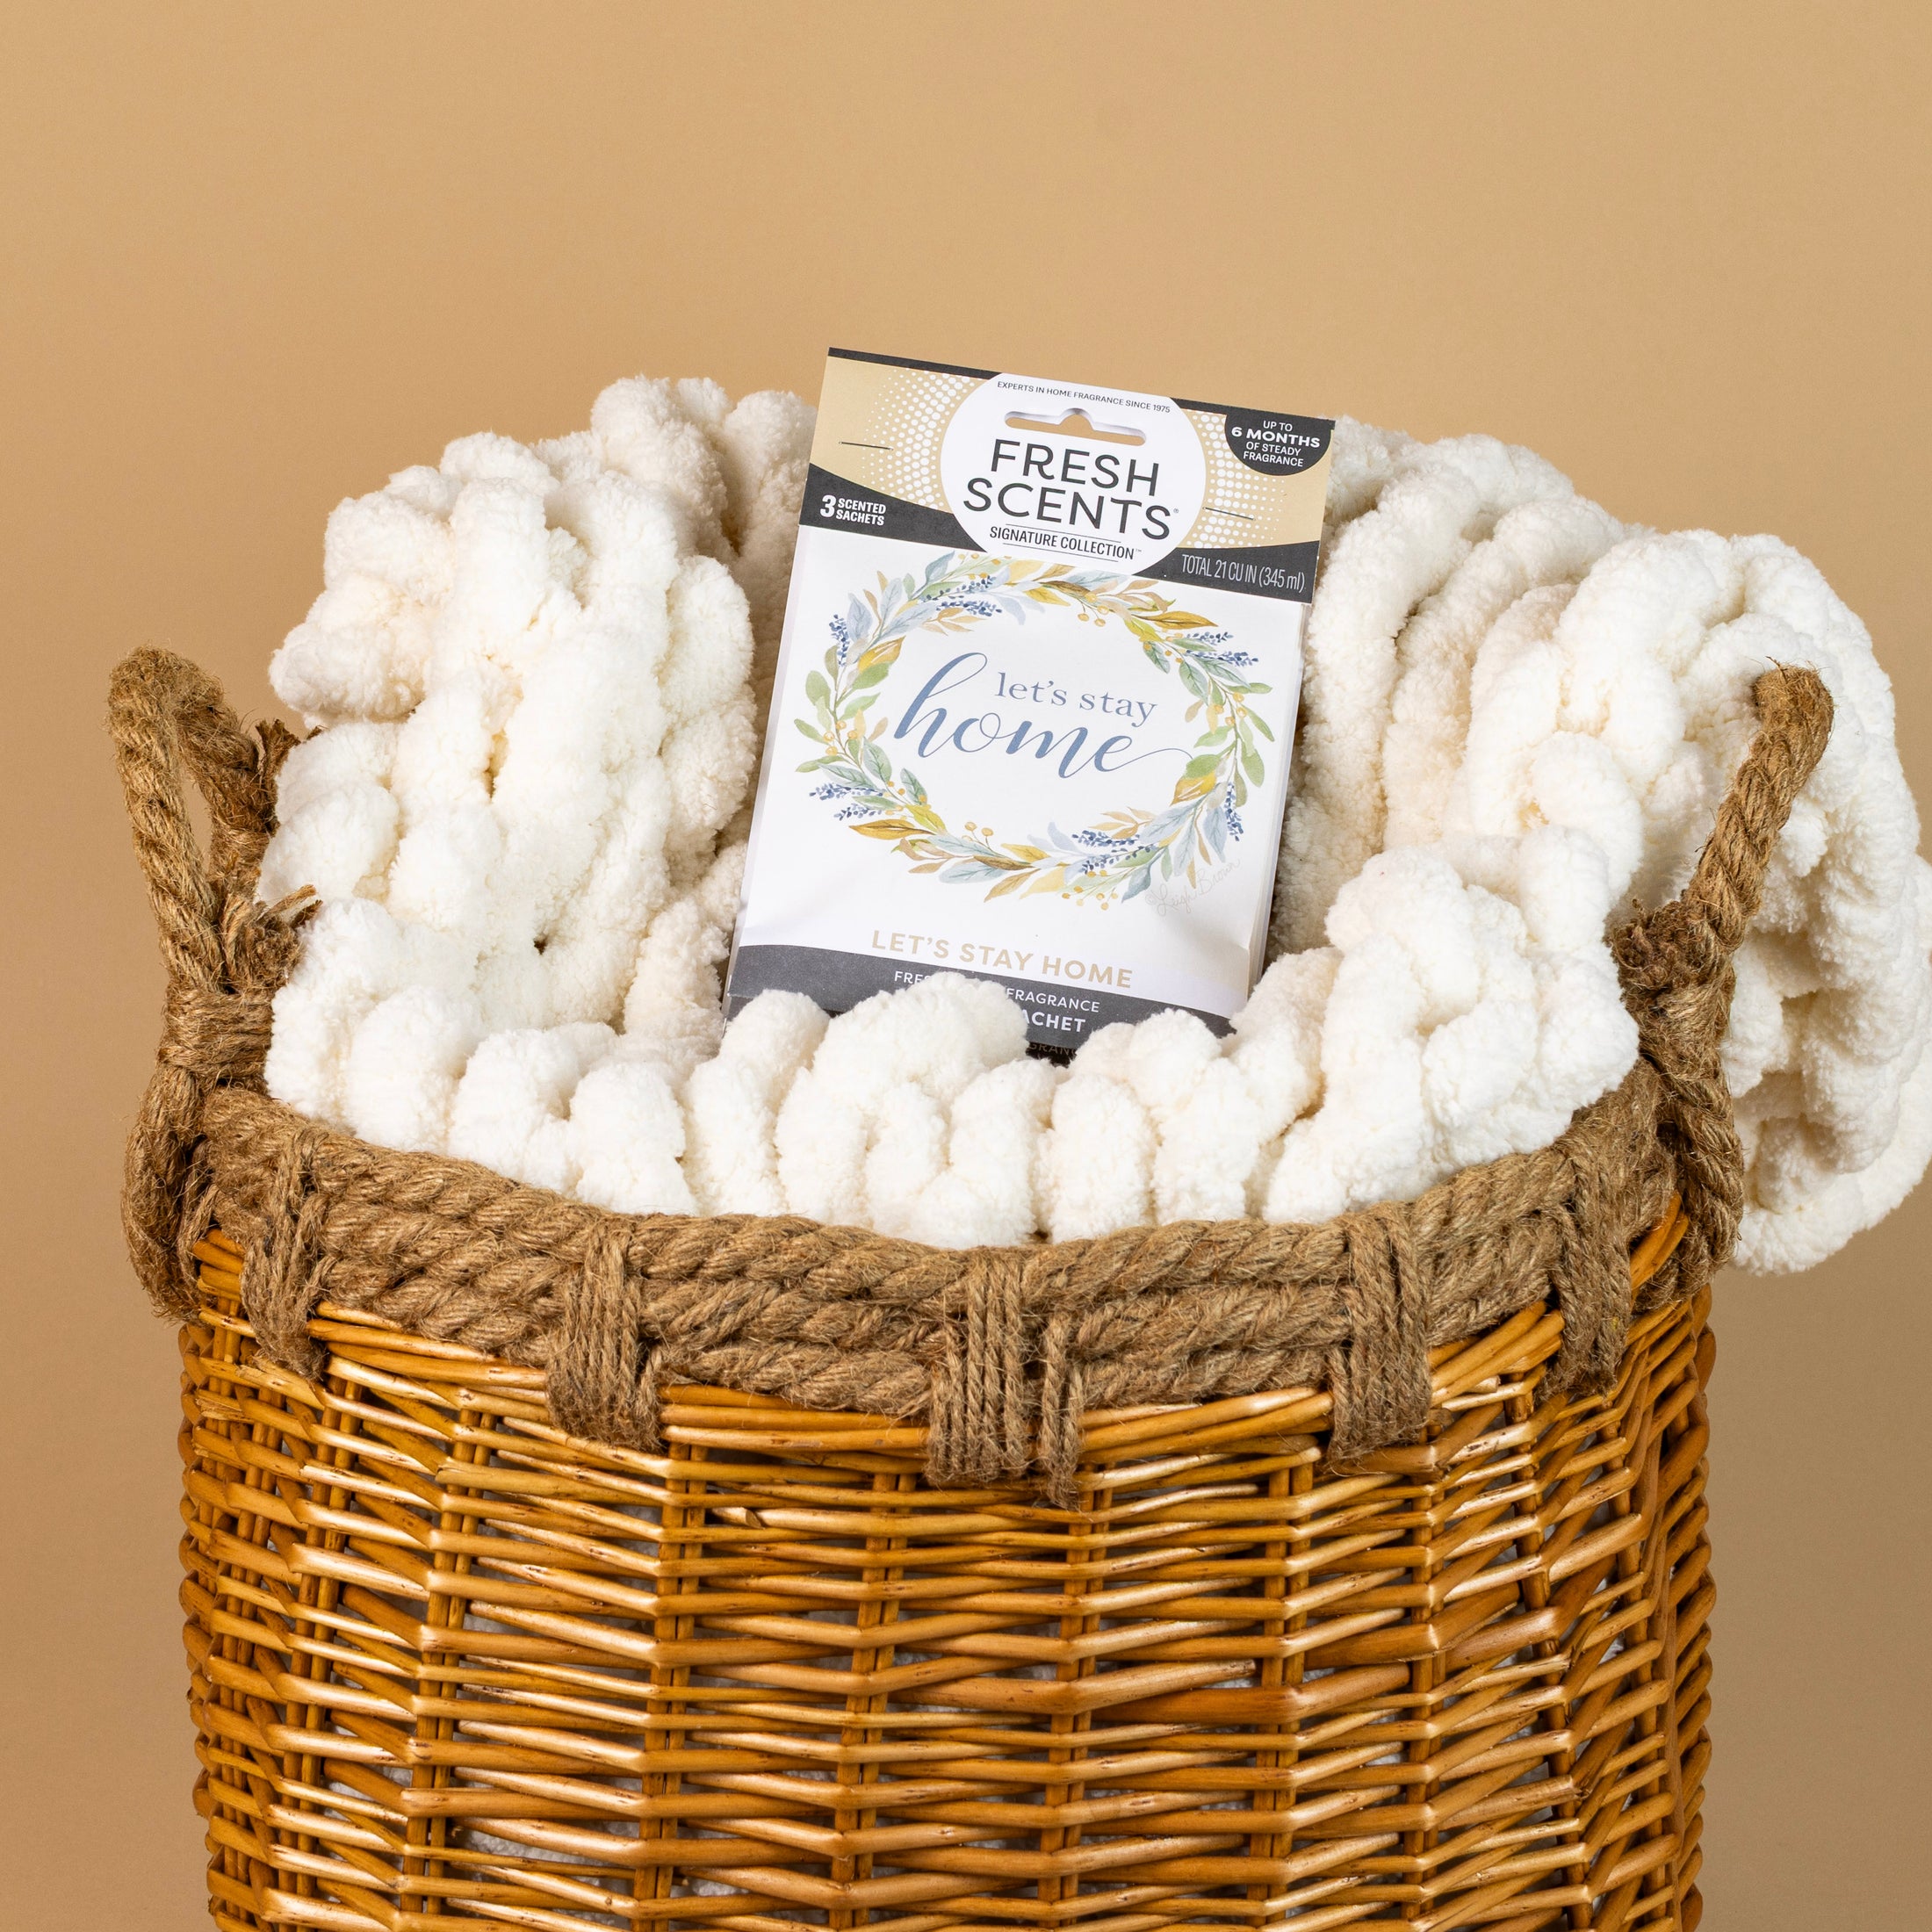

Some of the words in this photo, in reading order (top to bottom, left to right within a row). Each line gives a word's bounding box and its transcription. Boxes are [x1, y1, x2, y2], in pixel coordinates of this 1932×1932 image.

[998, 381, 1034, 393] EXPERTS
[1047, 388, 1071, 398] HOME
[1073, 392, 1124, 406] FRAGRANCE
[1125, 400, 1151, 410] SINCE
[1153, 404, 1171, 414] 1975
[1231, 427, 1243, 437] 6
[1246, 428, 1321, 448] MONTHS
[1263, 421, 1277, 429] UP
[1279, 422, 1293, 432] TO
[1244, 451, 1304, 467] FRAGRANCE
[1246, 441, 1260, 451] OF
[1262, 443, 1301, 457] STEADY
[991, 438, 1159, 496] FRESH
[819, 494, 836, 518] 3
[838, 498, 887, 515] SCENTED
[835, 509, 885, 526] SACHETS
[990, 526, 1057, 547] SIGNATURE
[1182, 554, 1212, 577] TOTAL
[1214, 559, 1227, 579] 21
[1229, 562, 1244, 581] CU
[1244, 565, 1258, 584] IN
[1258, 566, 1286, 588] (345
[1287, 572, 1305, 593] ml)
[994, 672, 1068, 706] let's
[1078, 692, 1158, 728] stay
[894, 652, 1193, 779] home
[872, 930, 949, 959] LET'S
[959, 943, 1034, 971] STAY
[1042, 955, 1133, 989] HOME
[1006, 988, 1100, 1013] FRAGRANCE
